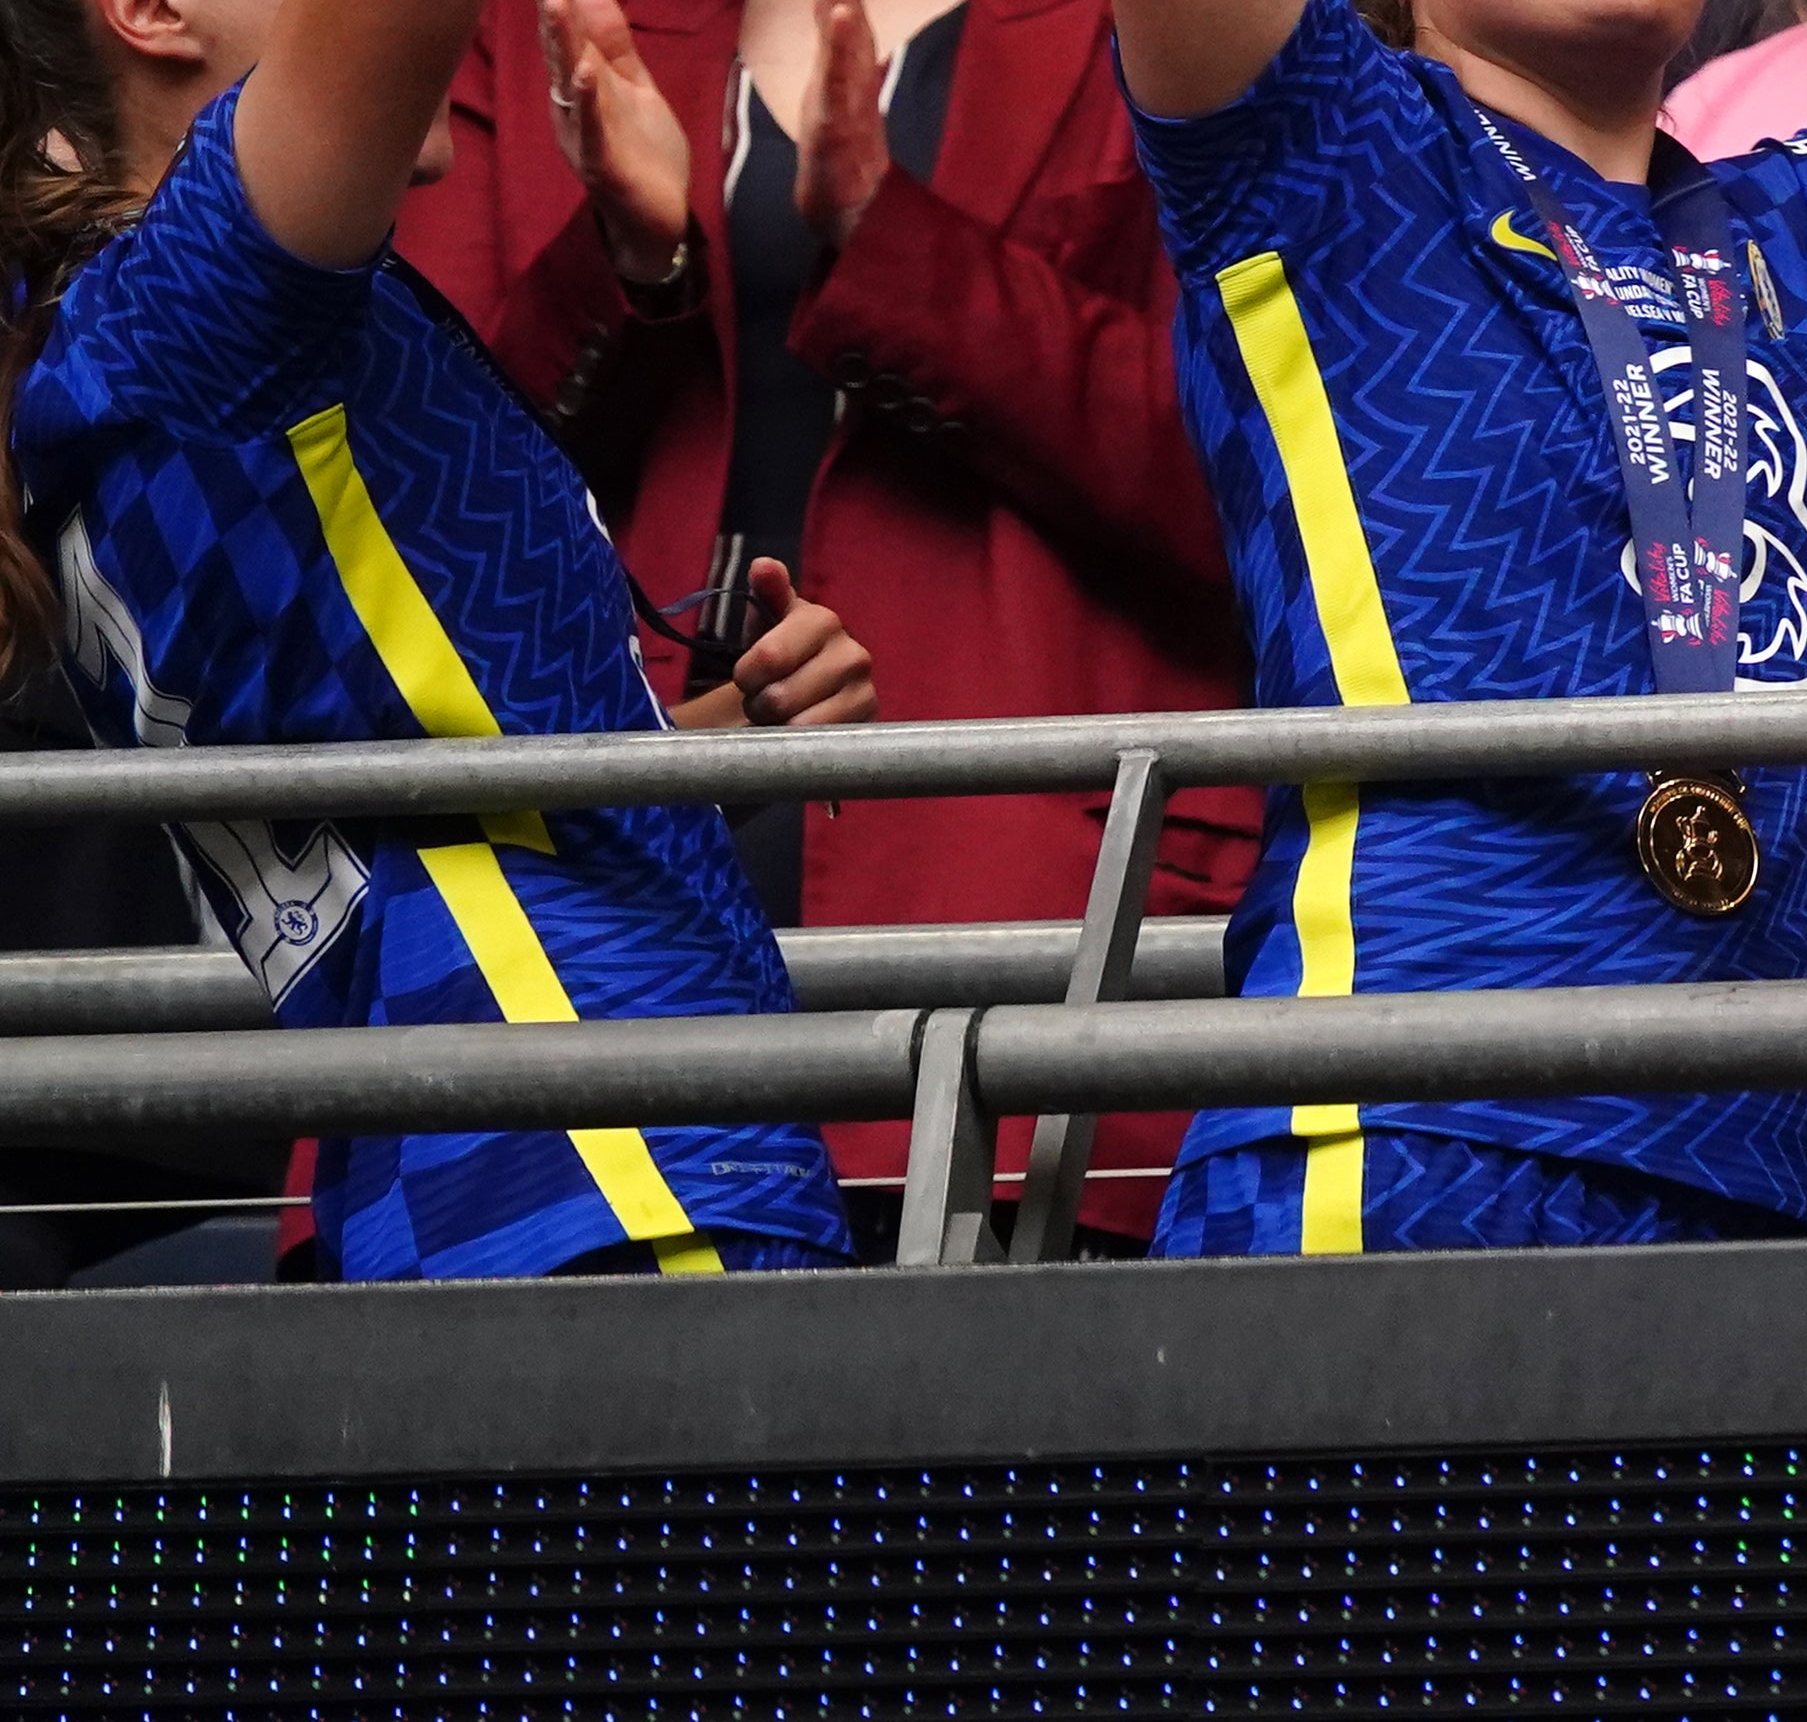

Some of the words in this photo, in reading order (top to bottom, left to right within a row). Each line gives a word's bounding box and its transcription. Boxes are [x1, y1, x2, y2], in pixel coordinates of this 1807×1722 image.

[1681, 273, 1698, 289] FA
[1686, 290, 1704, 320] CUP
[1613, 379, 1646, 465] 2021-22
[1625, 363, 1670, 485] WINNER
[1701, 368, 1722, 480] WINNER
[1722, 389, 1738, 472] 2021-22
[1645, 541, 1671, 602] Vitality
[1666, 556, 1680, 602] WOMEN'S
[1672, 543, 1690, 580] CUP
[1680, 582, 1694, 604] FA
